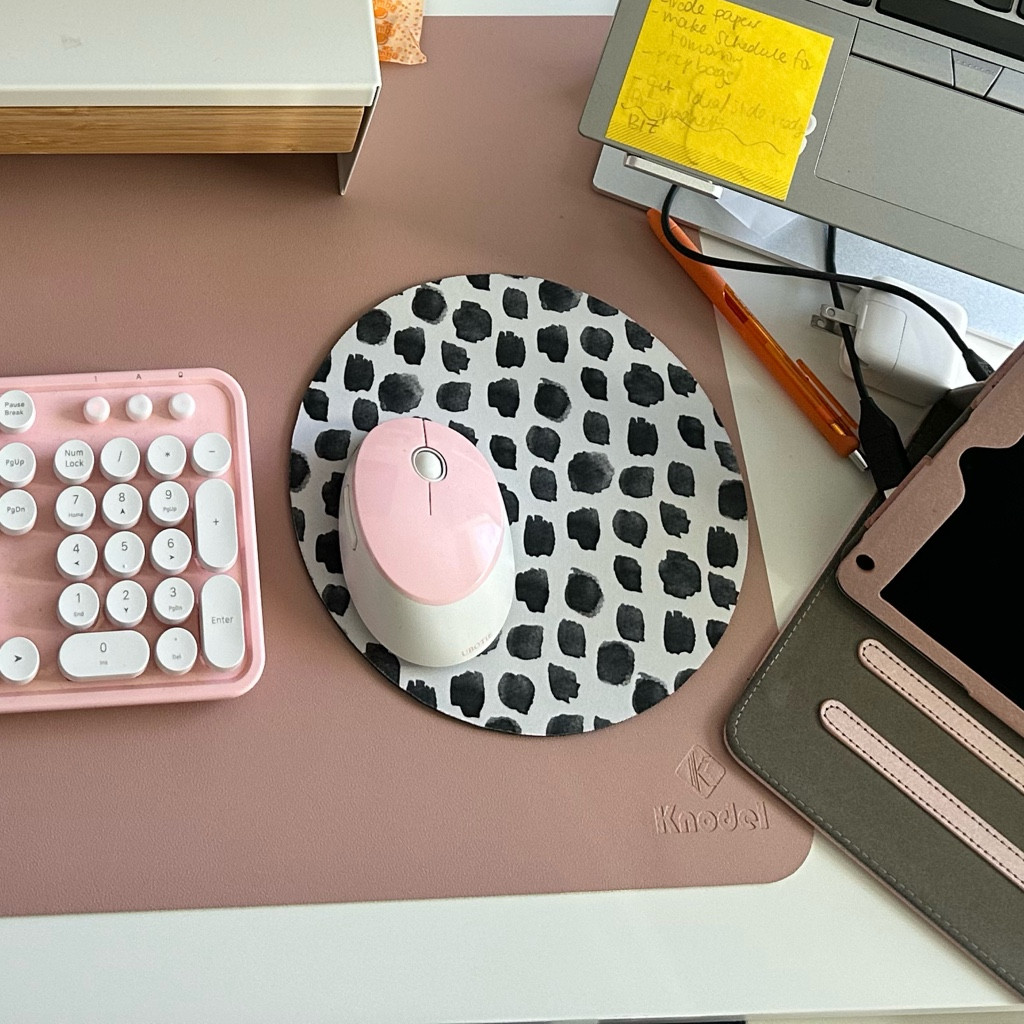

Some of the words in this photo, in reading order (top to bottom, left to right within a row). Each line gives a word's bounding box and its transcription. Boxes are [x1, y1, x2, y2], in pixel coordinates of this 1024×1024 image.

[64, 449, 85, 457] Num
[5, 458, 25, 468] PgUp
[65, 459, 85, 468] Lock
[6, 505, 26, 515] PgDn
[211, 616, 234, 625] Enter
[654, 801, 770, 834] Knodel
